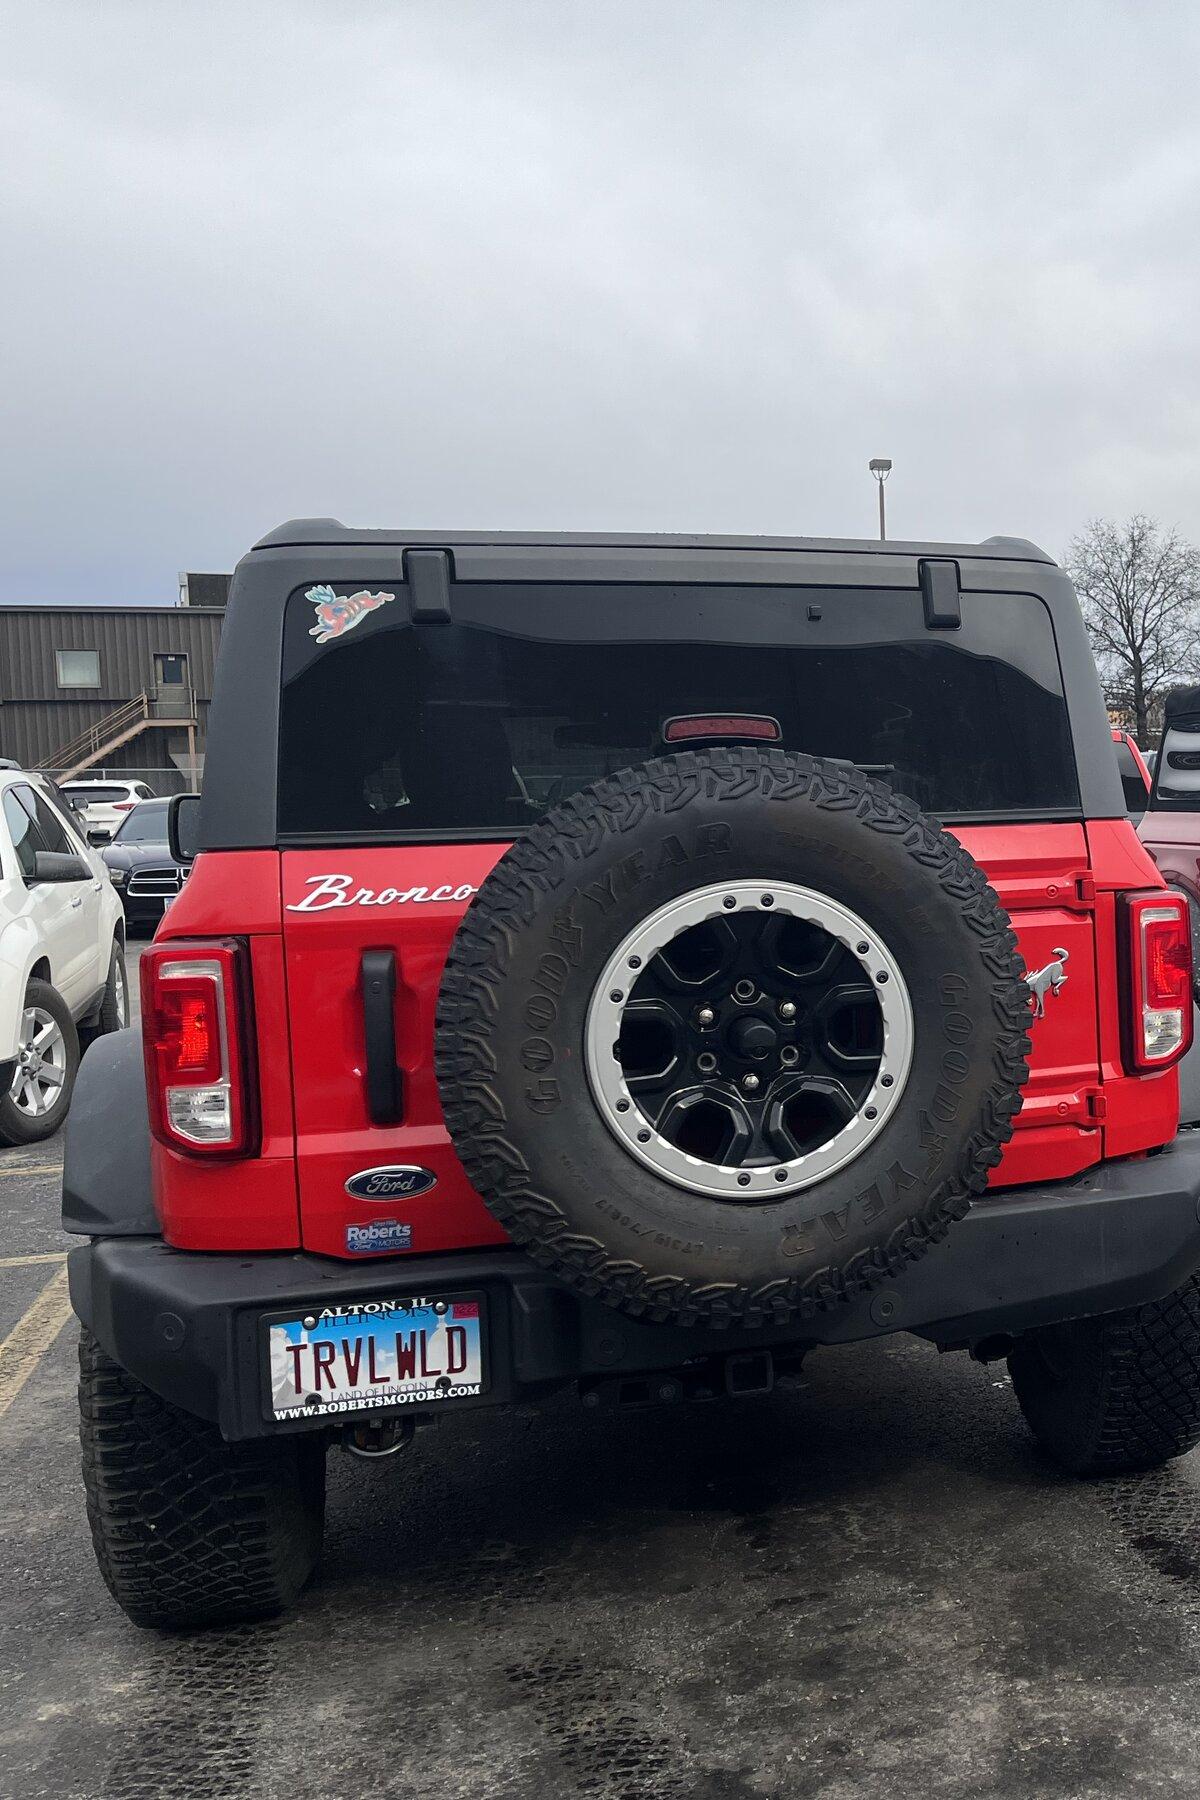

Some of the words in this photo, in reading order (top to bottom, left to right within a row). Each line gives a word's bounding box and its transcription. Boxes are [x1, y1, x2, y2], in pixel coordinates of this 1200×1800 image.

[285, 873, 479, 912] Bronco
[366, 1172, 416, 1194] Ford
[347, 1224, 411, 1241] Roberts
[379, 1237, 411, 1247] MOTORS
[411, 1297, 433, 1308] IL
[331, 1390, 362, 1402] LAND
[365, 1387, 378, 1398] OF
[382, 1381, 428, 1395] LINCOLN
[274, 1384, 480, 1421] WWW.ROBERTSMOTORS.COM
